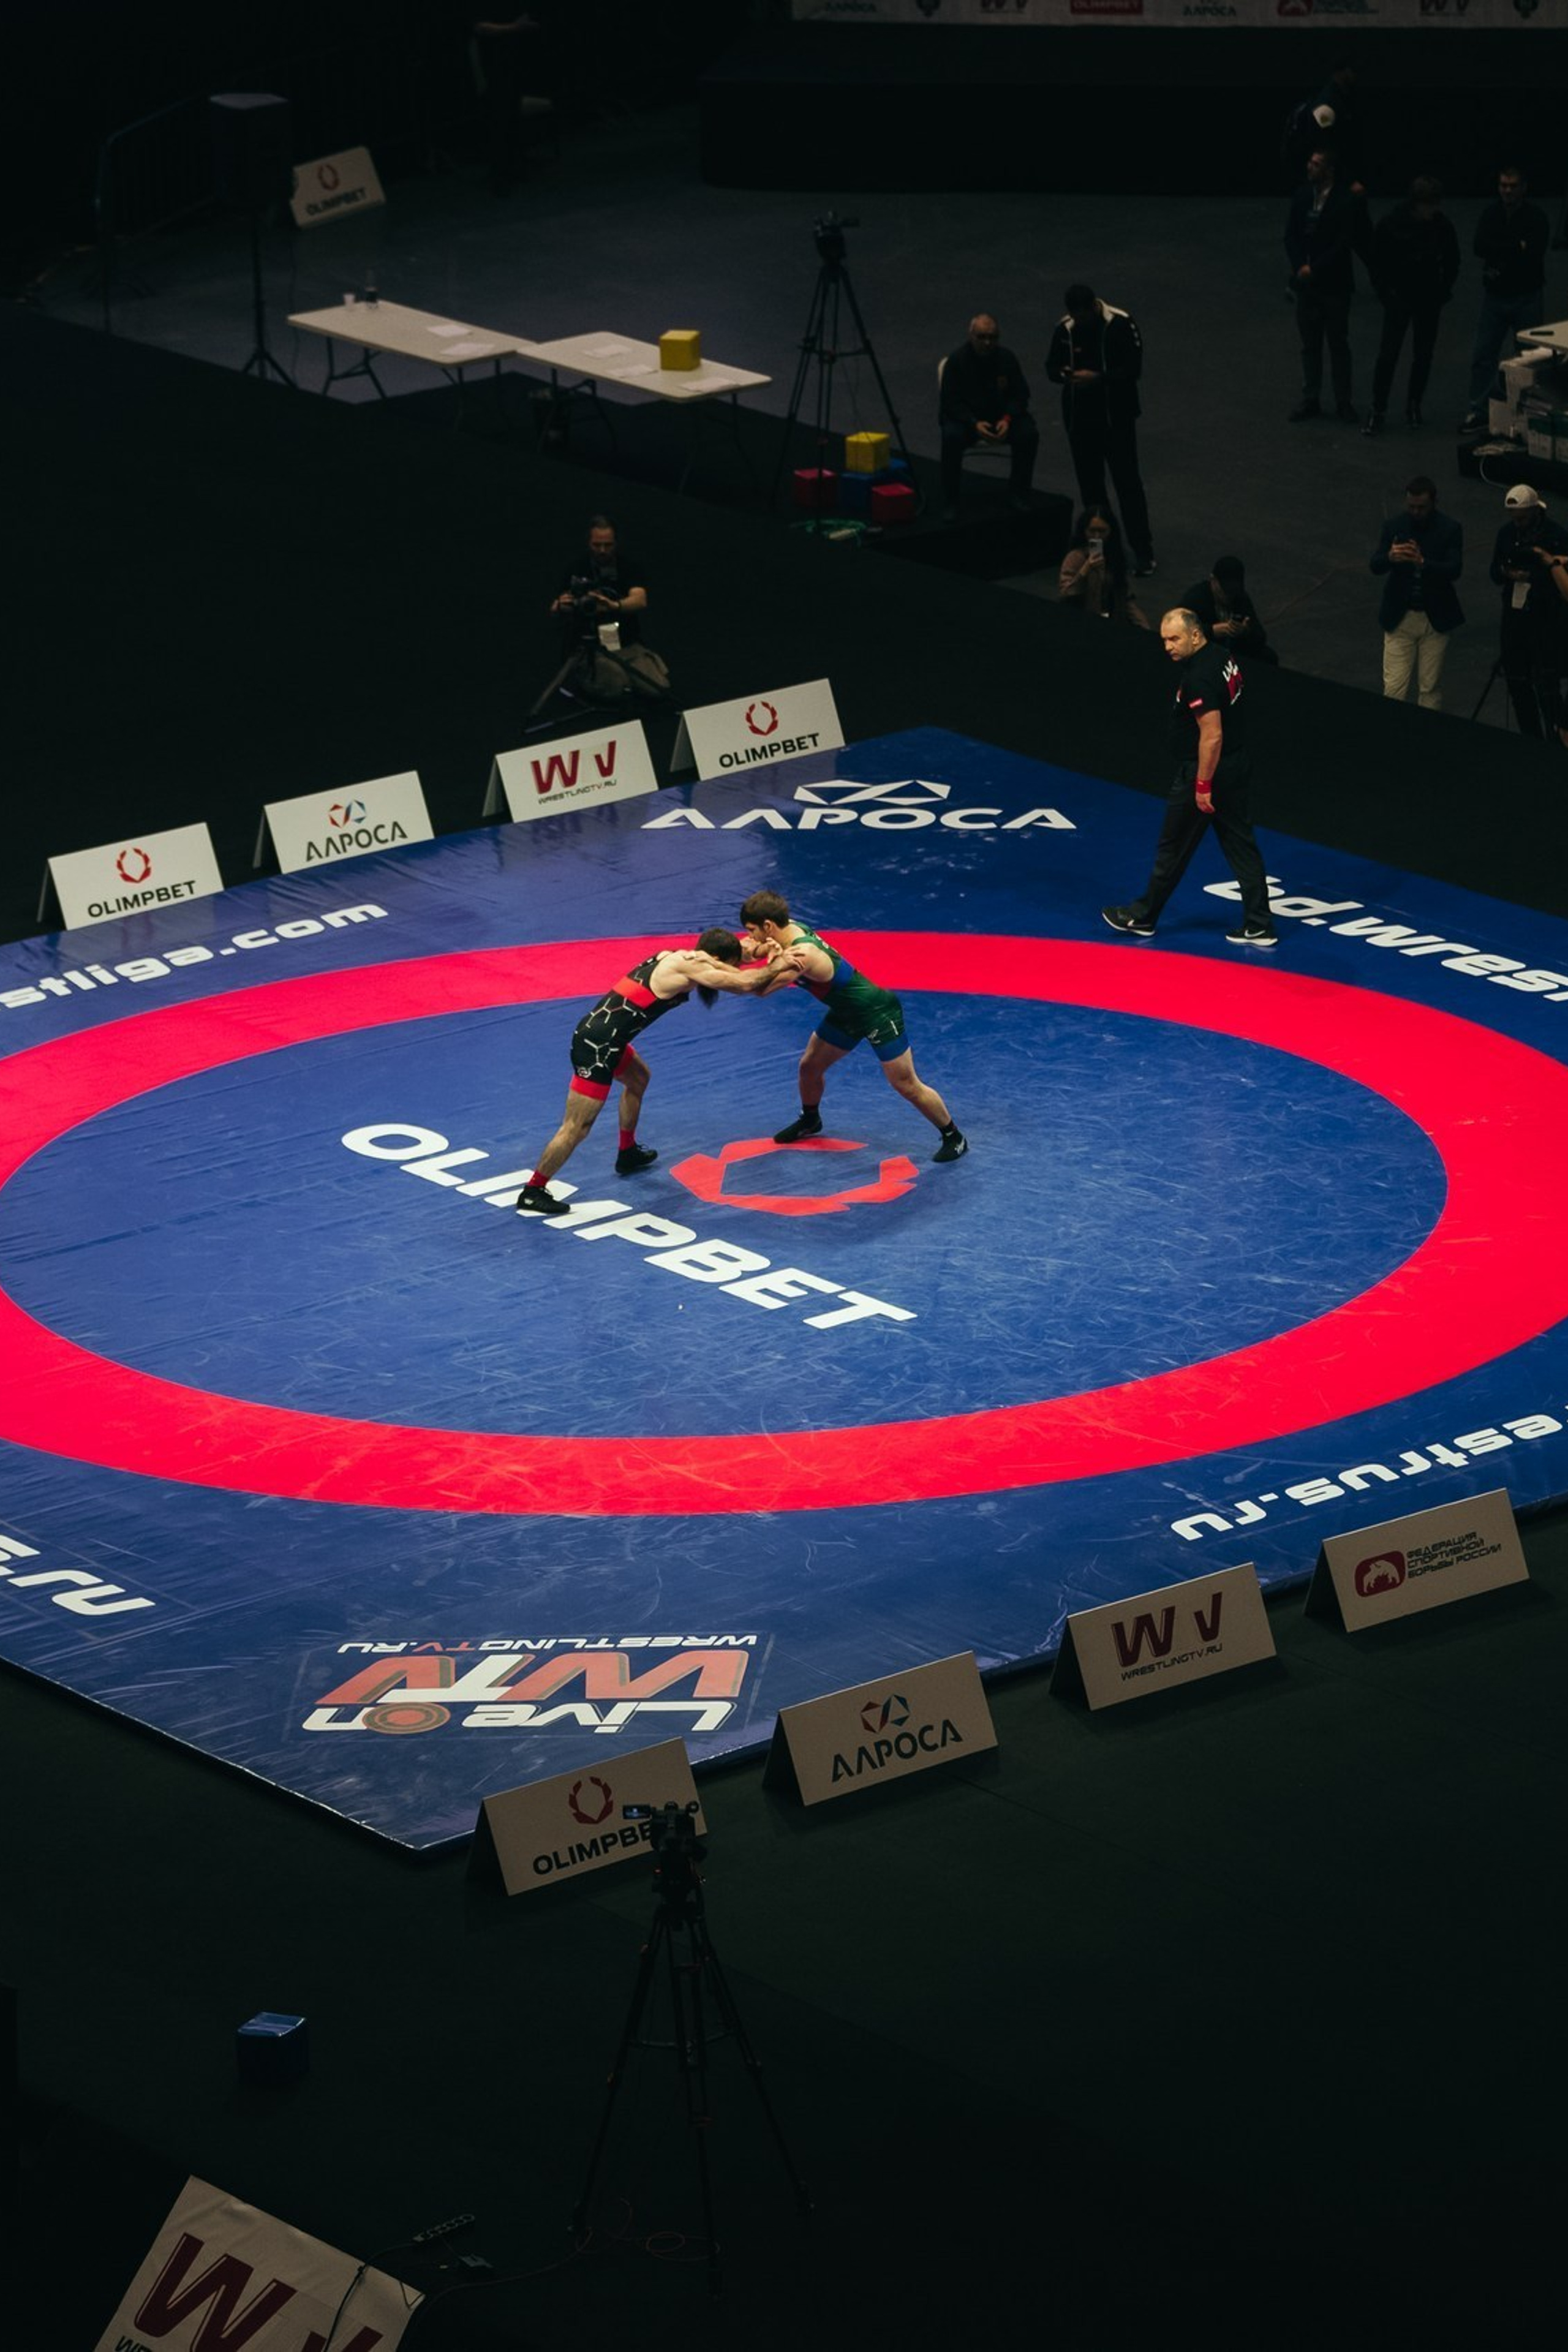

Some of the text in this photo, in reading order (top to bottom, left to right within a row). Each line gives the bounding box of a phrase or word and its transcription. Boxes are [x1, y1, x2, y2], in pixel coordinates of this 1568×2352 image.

[306, 186, 366, 216] OLIMPBET
[718, 733, 820, 768] OLIMPBET
[87, 880, 197, 918] OLIMPBET
[341, 1122, 919, 1330] OLIMPBET
[1170, 1403, 1568, 1542] estrus.ru
[1406, 1531, 1477, 1559] ФЕДЕРАЦИЯ
[1407, 1537, 1485, 1569] СПОРТИВНОЙ
[1407, 1543, 1502, 1579] БОРЬБЫ РОССИИ
[337, 1634, 758, 1654] WRESTLINGTV.RU
[1120, 1643, 1224, 1681] WRESTLINGTV.RU
[532, 1821, 653, 1875] OLIMPBE
